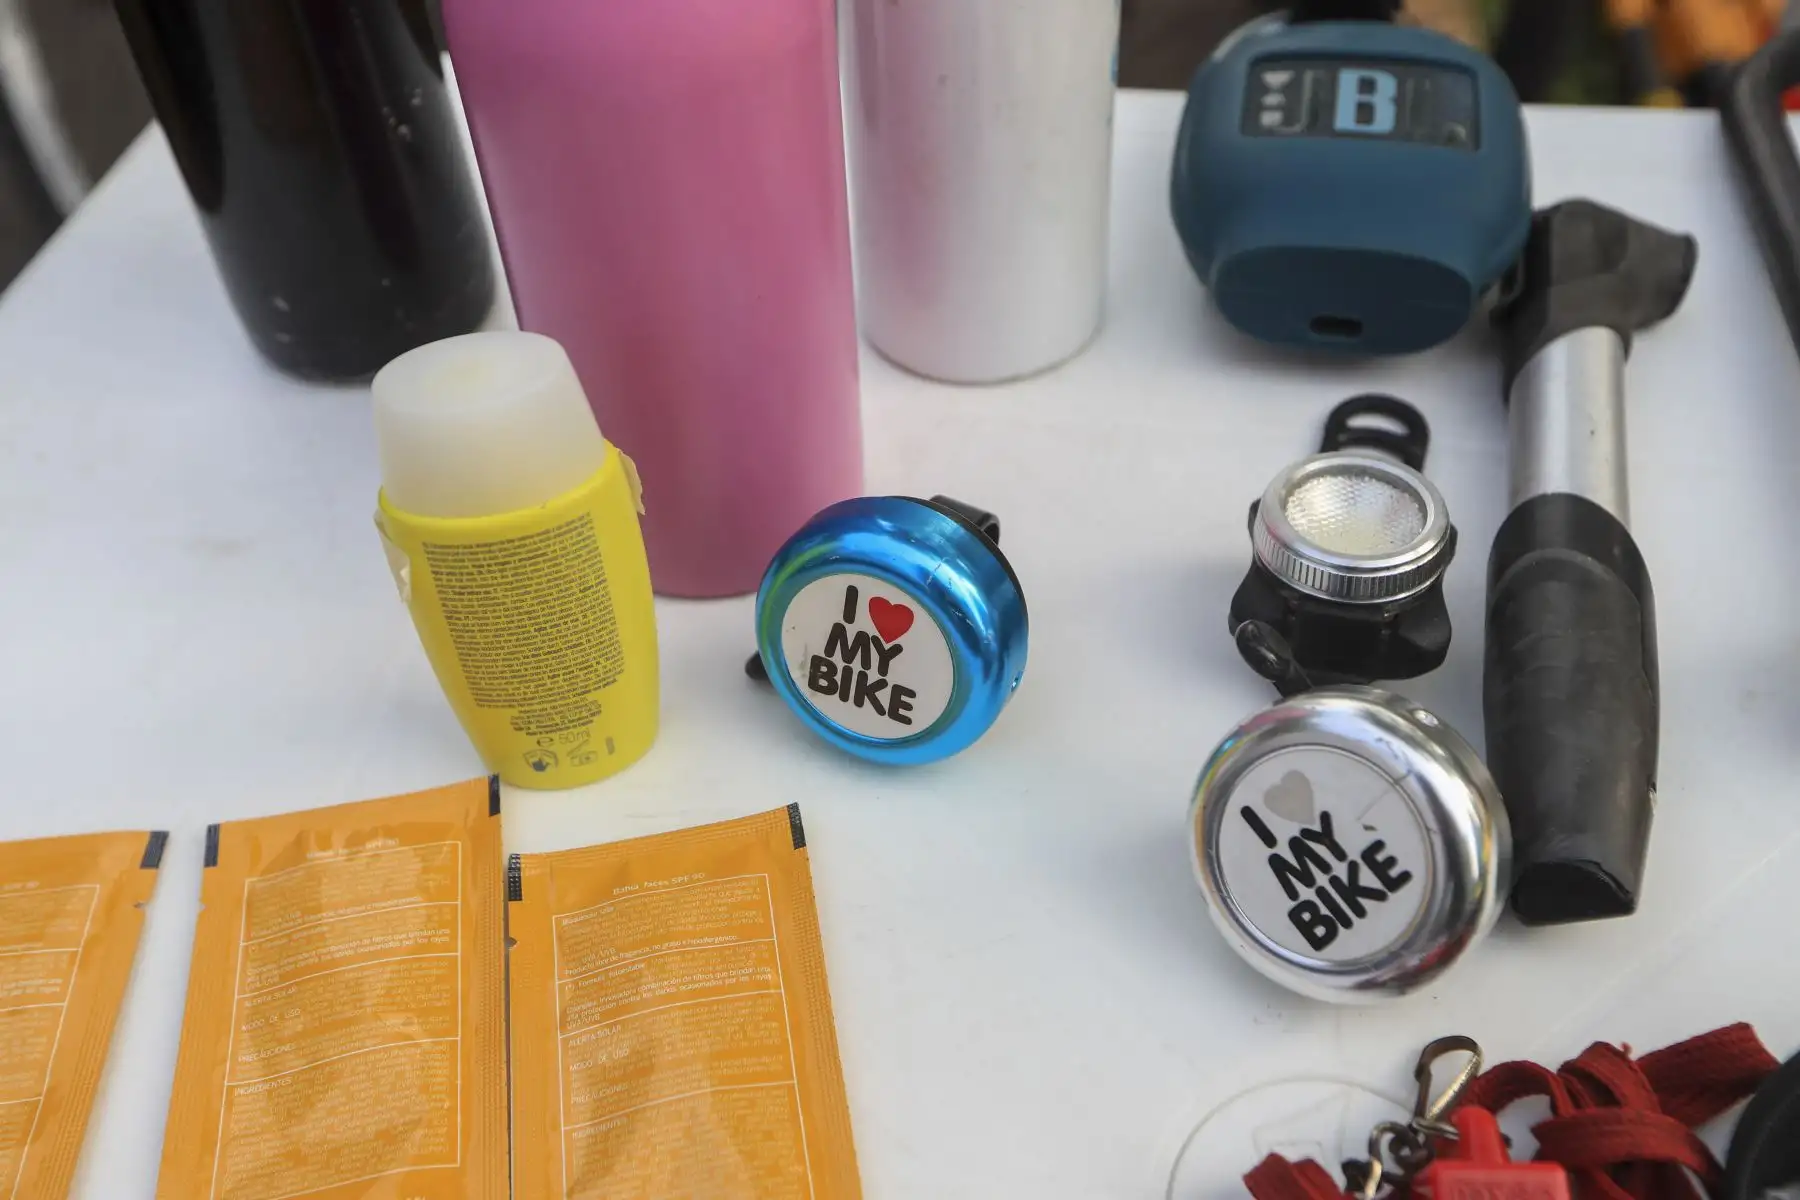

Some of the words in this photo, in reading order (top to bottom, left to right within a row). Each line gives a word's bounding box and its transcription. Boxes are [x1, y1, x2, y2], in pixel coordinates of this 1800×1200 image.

[843, 584, 859, 625] I
[823, 622, 904, 678] MY
[807, 654, 917, 726] BIKE
[1240, 805, 1278, 849] I
[1267, 810, 1348, 901] MY
[1287, 839, 1413, 952] BIKE
